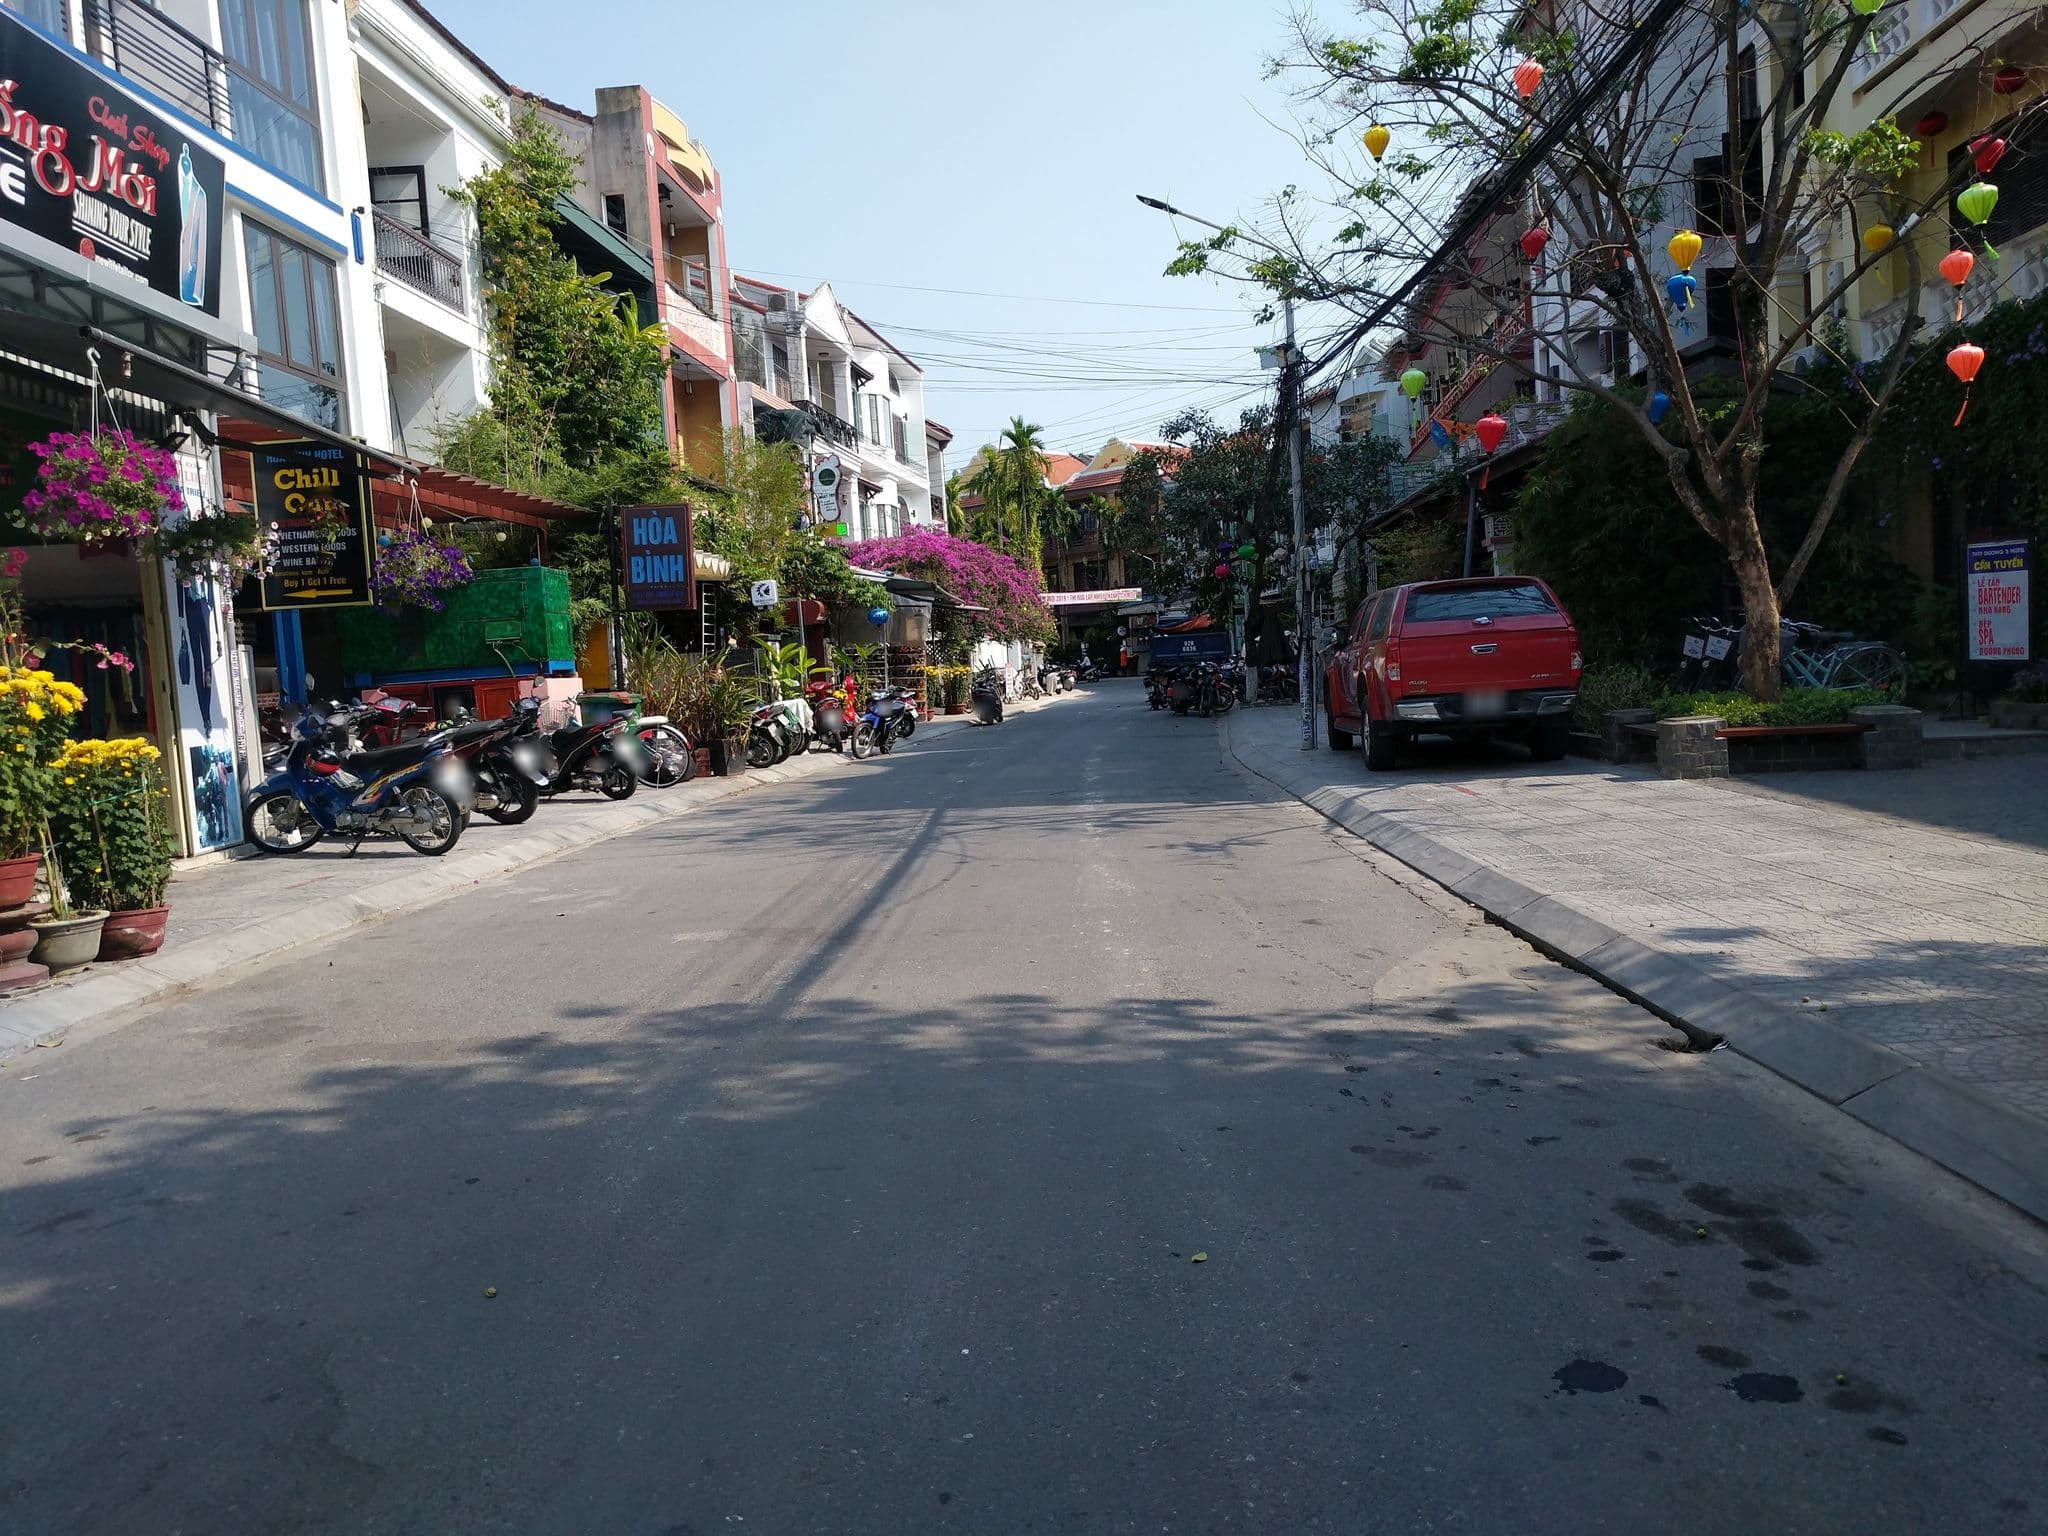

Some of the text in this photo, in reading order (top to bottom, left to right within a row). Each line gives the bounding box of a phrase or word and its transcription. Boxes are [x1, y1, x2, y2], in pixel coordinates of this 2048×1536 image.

[128, 126, 171, 172] Shop
[75, 134, 157, 217] Mới
[72, 188, 153, 255] SHINING YOUR STYLE
[314, 448, 344, 460] HOTEL
[273, 467, 340, 490] Chill
[633, 510, 679, 546] HÒA
[281, 543, 320, 555] WESTERN
[282, 558, 304, 568] WINE
[630, 549, 685, 584] BÌNH
[283, 578, 299, 588] Buy
[329, 576, 347, 585] Free
[1978, 586, 2021, 605] BARTENDER
[1978, 628, 1994, 645] SPA
